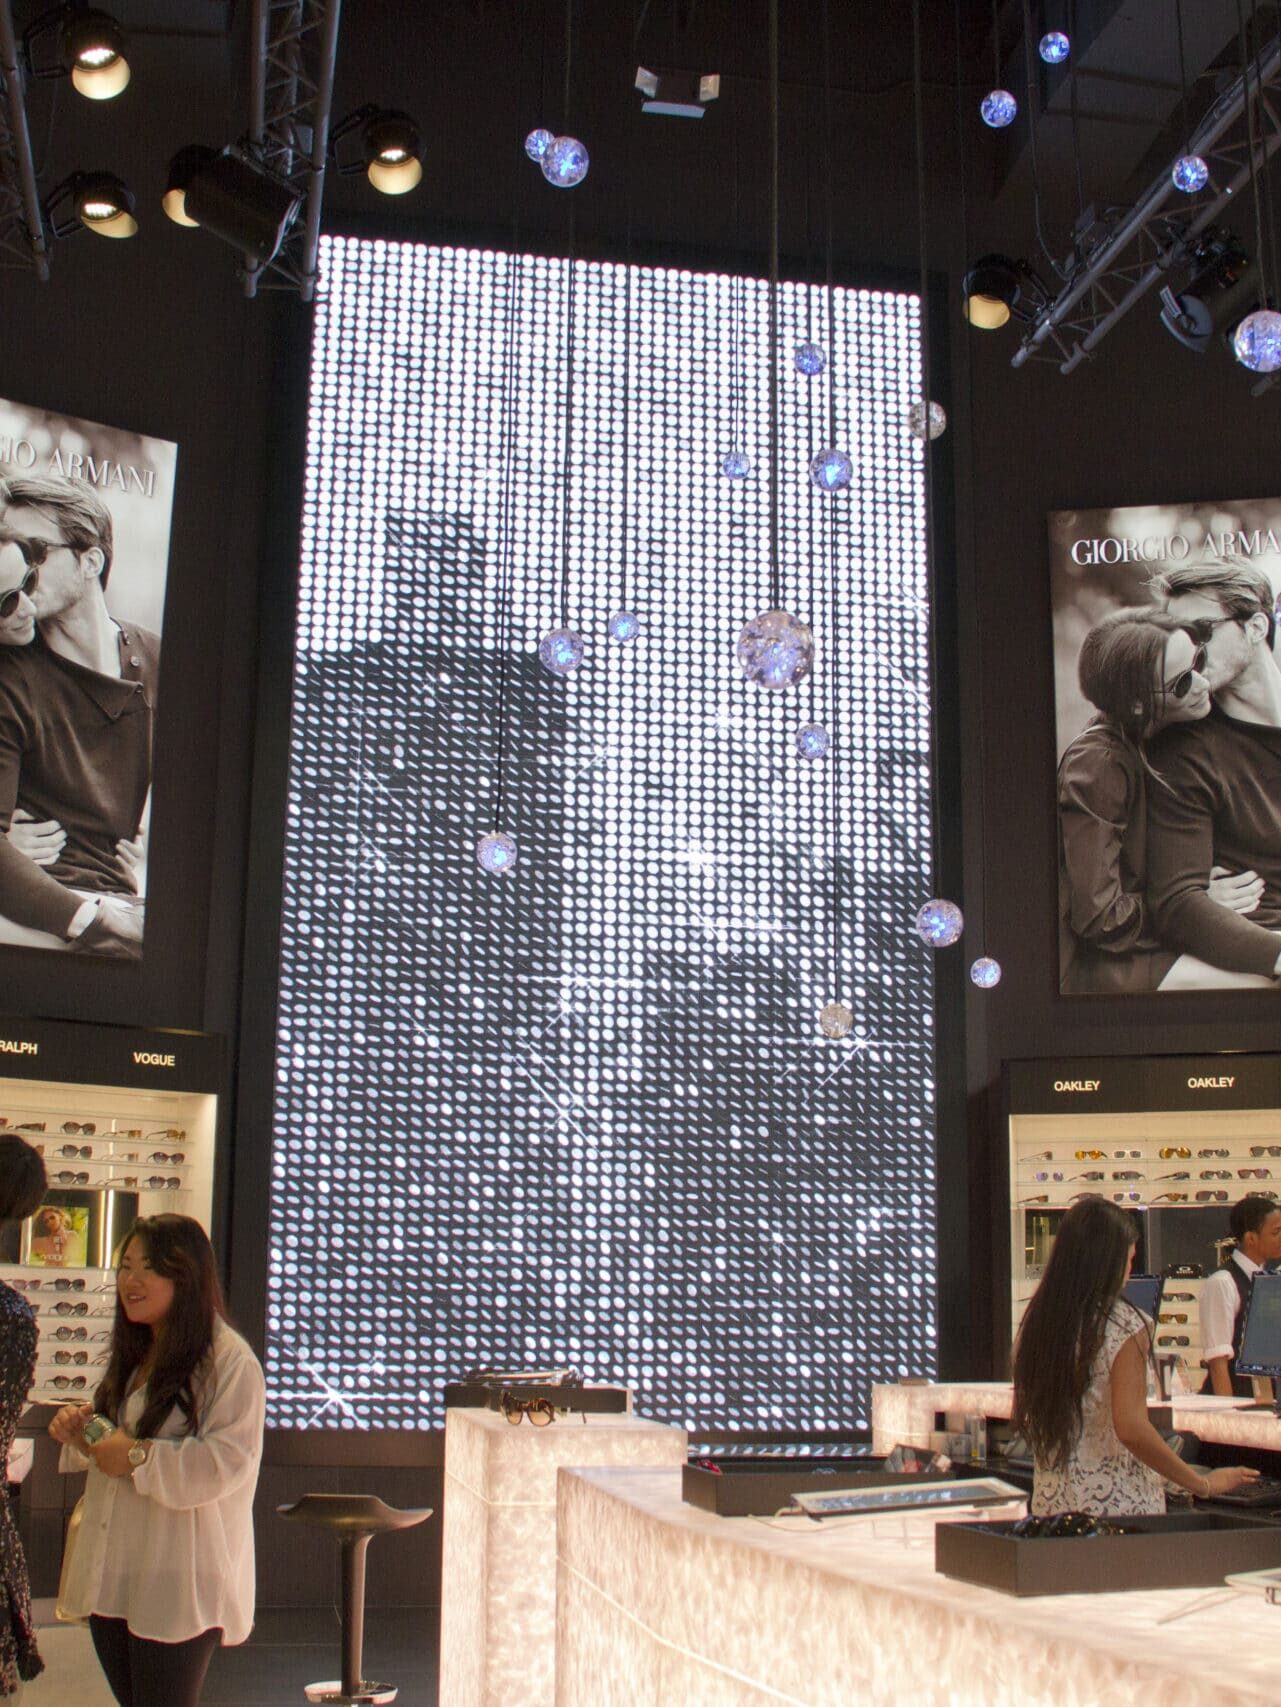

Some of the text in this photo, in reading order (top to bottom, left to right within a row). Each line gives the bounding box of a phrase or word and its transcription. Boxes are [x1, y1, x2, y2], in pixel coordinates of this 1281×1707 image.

[0, 436, 156, 498] IO ARMANI
[1071, 535, 1190, 566] GIORGIO
[0, 1040, 38, 1055] RALPH
[133, 1052, 176, 1067] VOGUE
[1053, 1079, 1101, 1092] OAKLEY
[1187, 1076, 1235, 1089] OAKLEY
